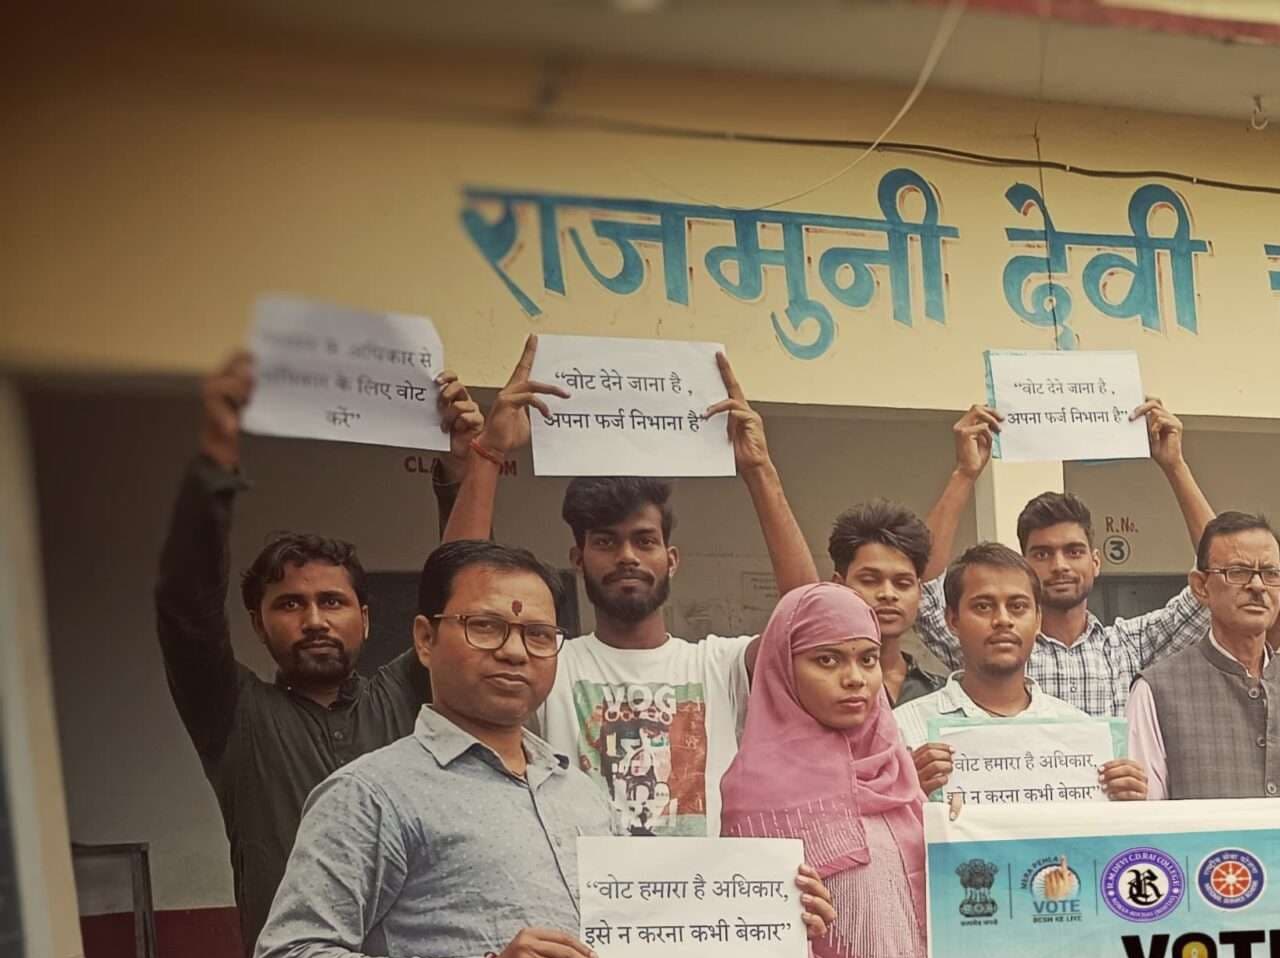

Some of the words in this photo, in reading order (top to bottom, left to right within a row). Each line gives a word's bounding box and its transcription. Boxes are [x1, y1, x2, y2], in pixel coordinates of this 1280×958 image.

[460, 167, 961, 361] राजमुनी
[1004, 181, 1212, 350] देवी
[396, 380, 427, 402] वोट
[600, 369, 622, 391] देने
[627, 375, 665, 393] जाना
[1047, 377, 1064, 395] देने
[1067, 382, 1094, 395] जाना
[544, 413, 590, 430] अपना
[595, 409, 625, 430] फर्ज
[629, 409, 683, 431] निभाना
[1007, 411, 1041, 425] अपना
[1044, 407, 1066, 423] फर्ज
[1070, 407, 1109, 424] निभाना
[1110, 540, 1125, 561] 3
[983, 756, 1021, 772] हमारा
[1024, 751, 1035, 771] है
[970, 790, 981, 804] न
[985, 788, 1020, 804] करना
[1024, 783, 1055, 801] कभी
[586, 873, 634, 899] “वोट
[638, 880, 688, 900] हमारा
[693, 874, 706, 900] है
[711, 873, 789, 902] अधिकार,
[1033, 899, 1081, 913] VOTE
[585, 919, 613, 948] इसे
[617, 926, 632, 944] न
[636, 926, 684, 943] करना
[689, 918, 730, 942] कभी
[735, 917, 791, 942] बेकार”
